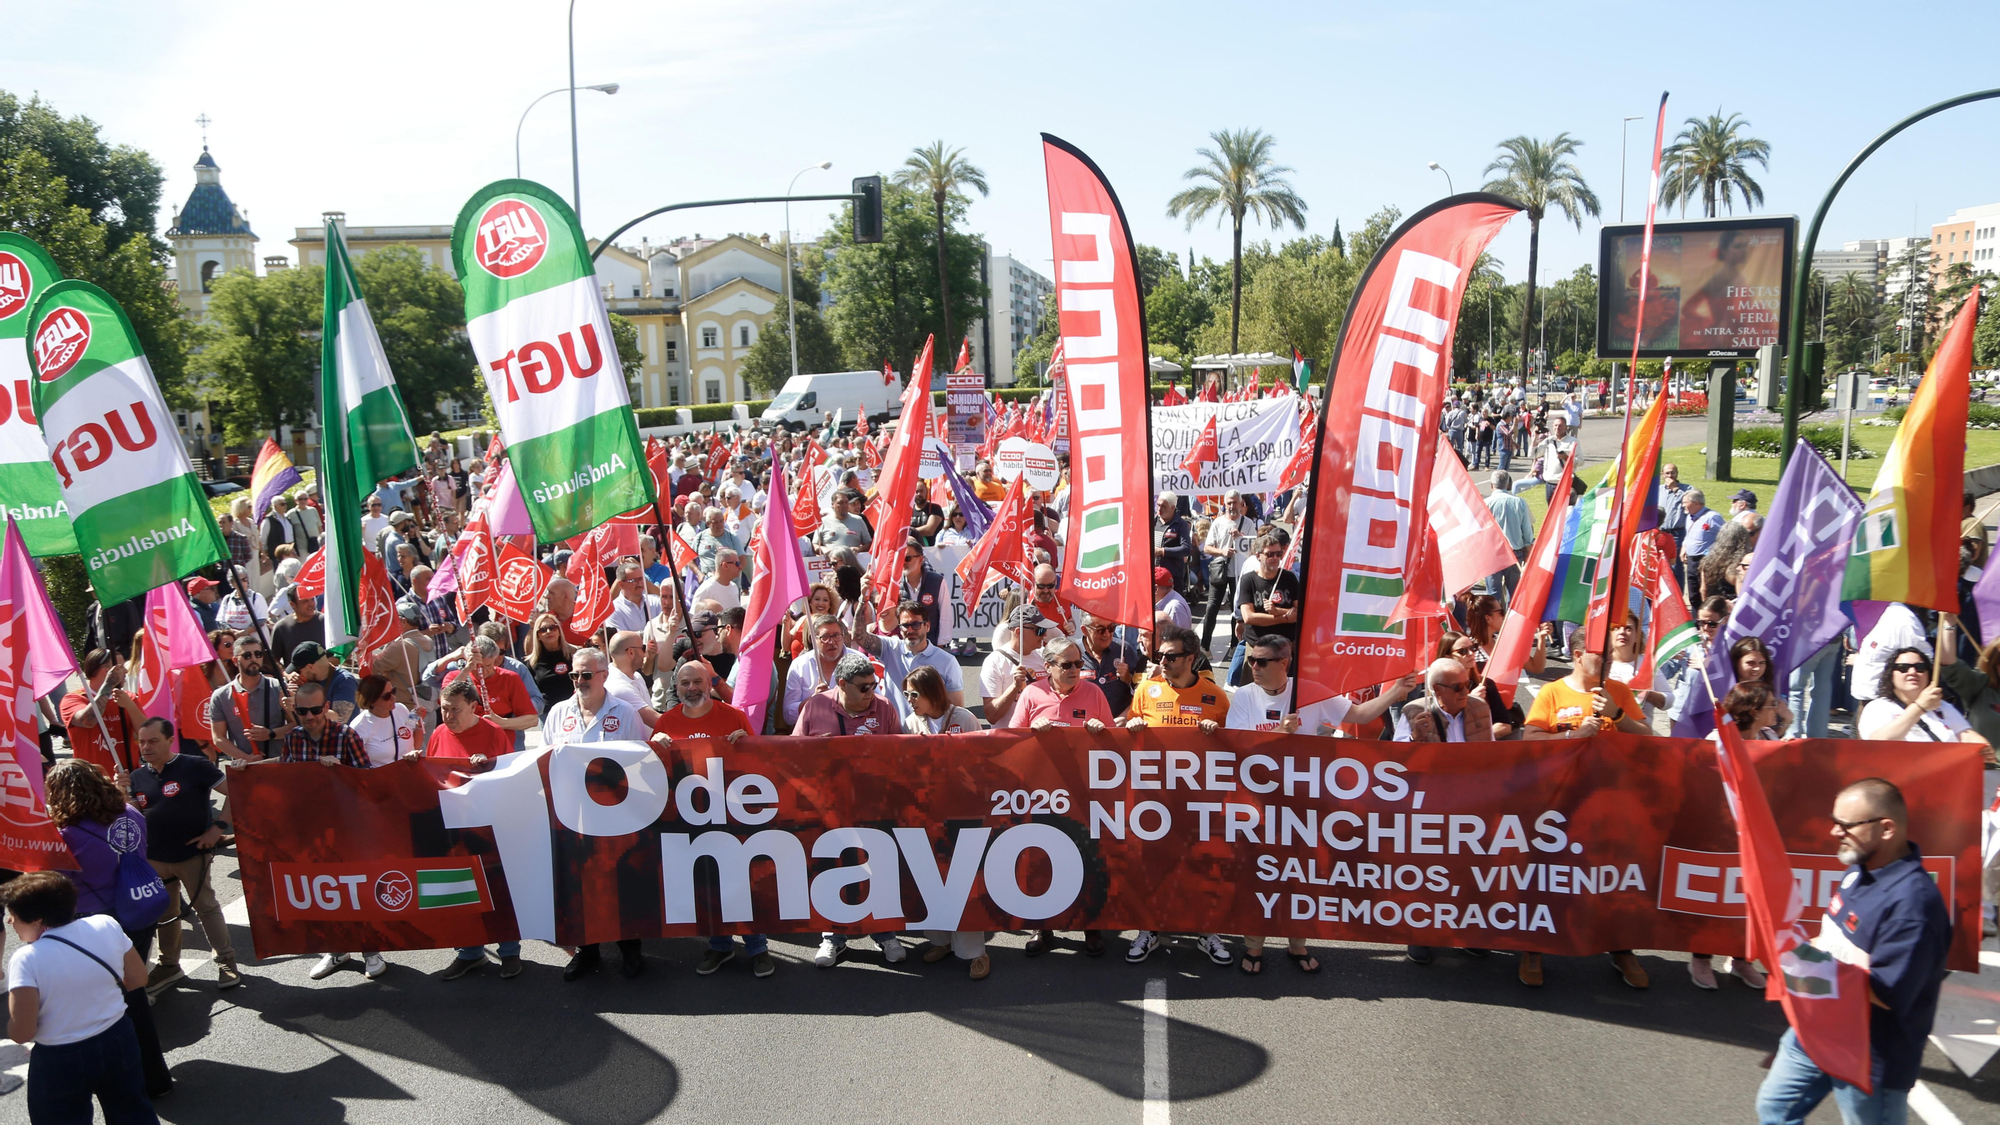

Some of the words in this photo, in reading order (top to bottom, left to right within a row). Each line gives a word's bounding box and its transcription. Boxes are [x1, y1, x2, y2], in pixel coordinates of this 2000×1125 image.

[1726, 285, 1780, 298] FIESTAS
[1738, 299, 1780, 311] MAYO
[1739, 312, 1780, 323] FERIA
[1731, 336, 1778, 348] SALUD
[947, 376, 985, 386] CCOO
[948, 393, 984, 405] SANIDAD
[955, 404, 980, 414] PÚBLICA
[1235, 439, 1293, 464] TRABAJO
[920, 459, 942, 467] ábitat
[1003, 461, 1023, 469] hábita
[1026, 459, 1046, 468] CCOO
[1029, 468, 1052, 478] hábitat
[500, 562, 525, 593] UGT
[1333, 641, 1406, 658] Córdoba
[604, 717, 618, 725] UGT
[1162, 714, 1200, 726] Hitachi
[1088, 750, 1425, 810] DERECHOS,
[674, 757, 779, 826] de
[990, 788, 1071, 816] 2026
[1089, 800, 1172, 841] NO
[1186, 801, 1583, 856] TRINCHERAS.
[660, 823, 1084, 931] mayo
[1255, 854, 1461, 898] SALARIOS,
[1471, 862, 1646, 895] VIVIENDA
[130, 881, 159, 901] UGT
[284, 874, 367, 911] UGT
[1255, 892, 1281, 919] Y
[1290, 893, 1557, 934] DEMOCRACIA
